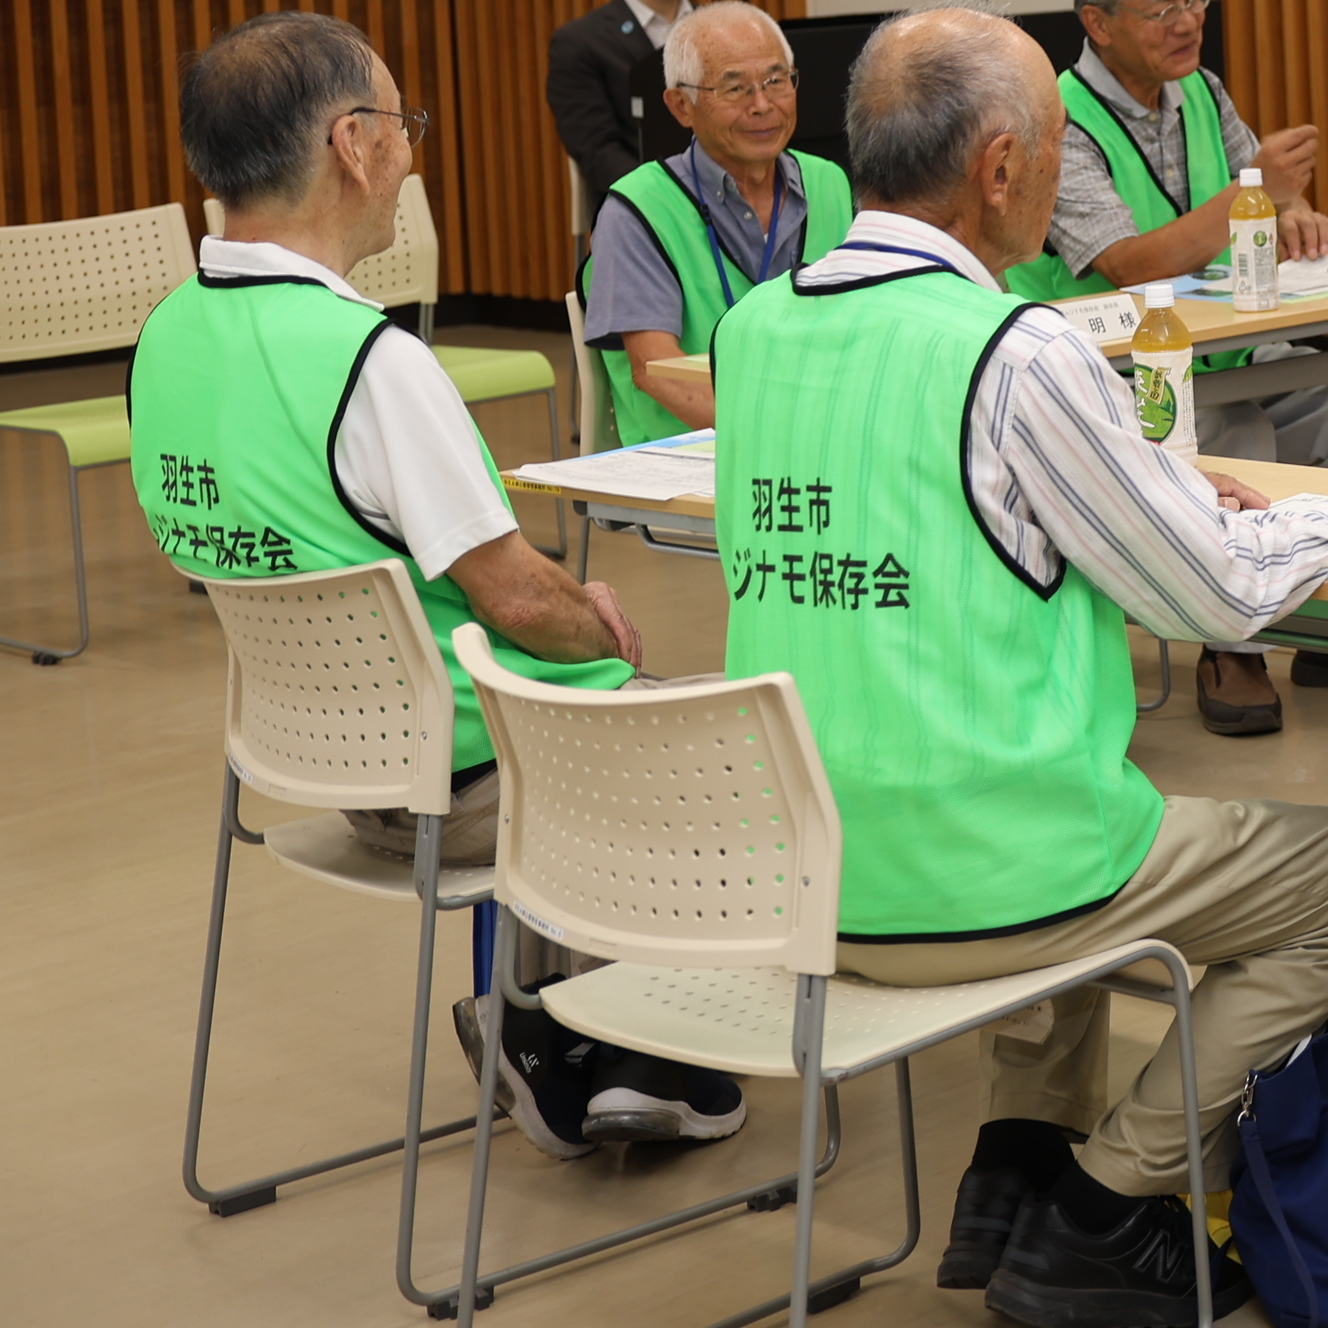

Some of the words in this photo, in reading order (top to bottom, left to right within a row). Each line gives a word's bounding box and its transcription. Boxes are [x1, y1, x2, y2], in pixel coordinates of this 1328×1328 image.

[1063, 305, 1100, 316] ムジナモ保存会
[1088, 316, 1107, 334] 明
[1118, 311, 1137, 330] 様
[160, 453, 220, 510] 羽生市
[751, 476, 833, 535] 羽生市
[732, 547, 911, 610] ジナモ保存会
